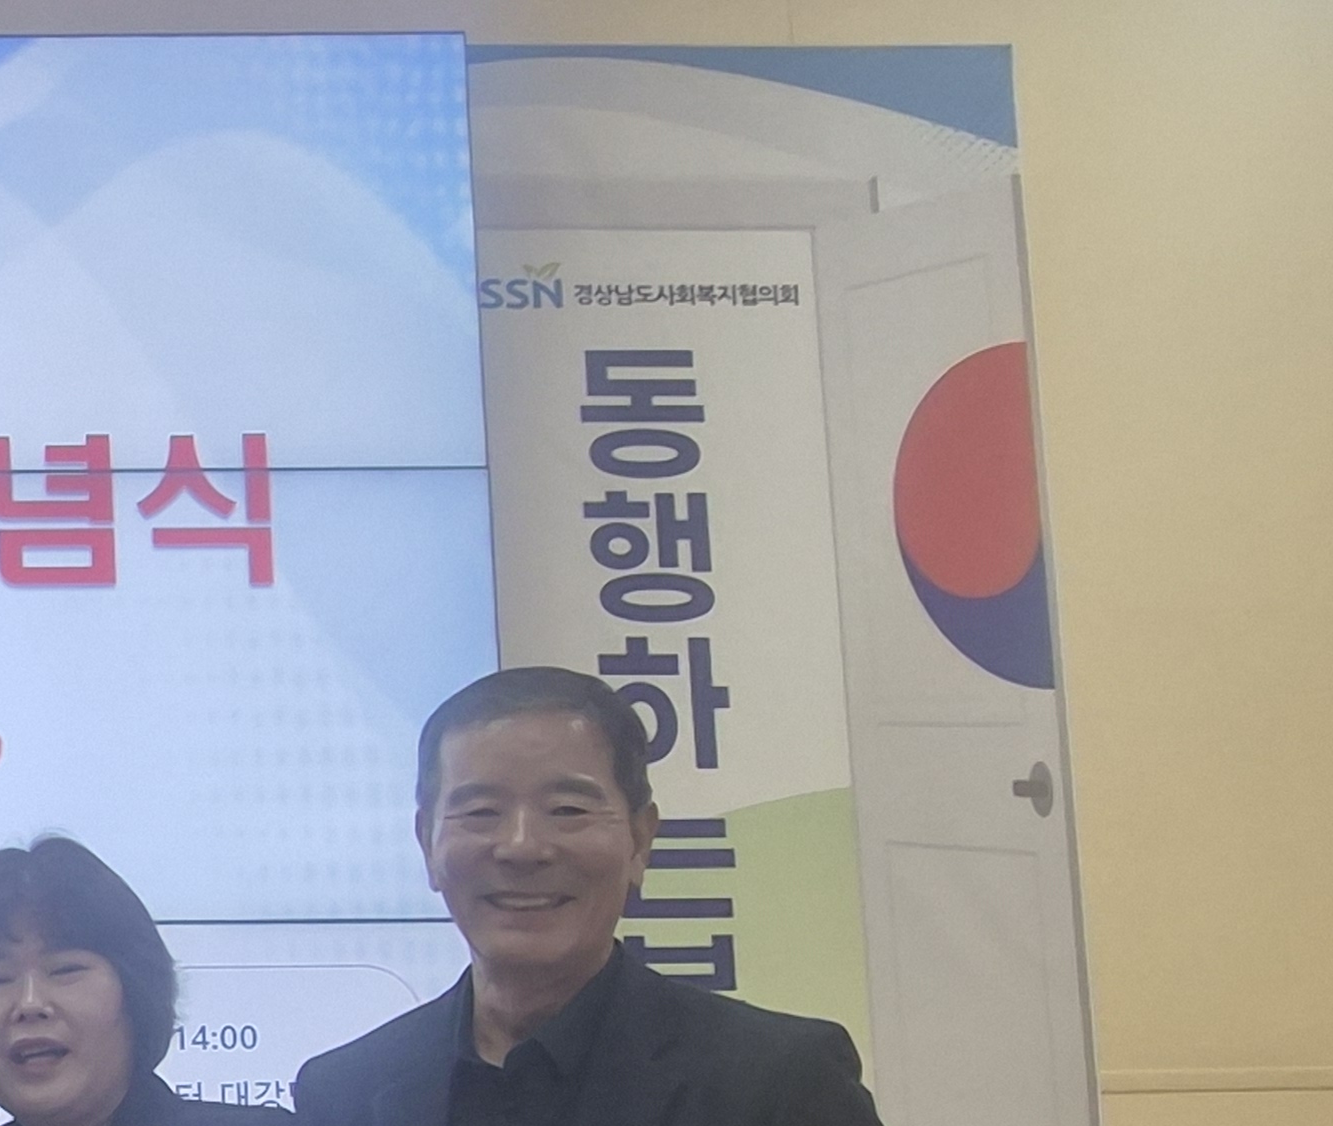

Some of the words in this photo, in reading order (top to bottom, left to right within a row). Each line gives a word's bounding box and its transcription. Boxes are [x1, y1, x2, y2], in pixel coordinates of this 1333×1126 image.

[479, 278, 564, 309] SSN
[574, 284, 800, 306] 경상남도사회복지협의회
[174, 1025, 258, 1050] 14:00
